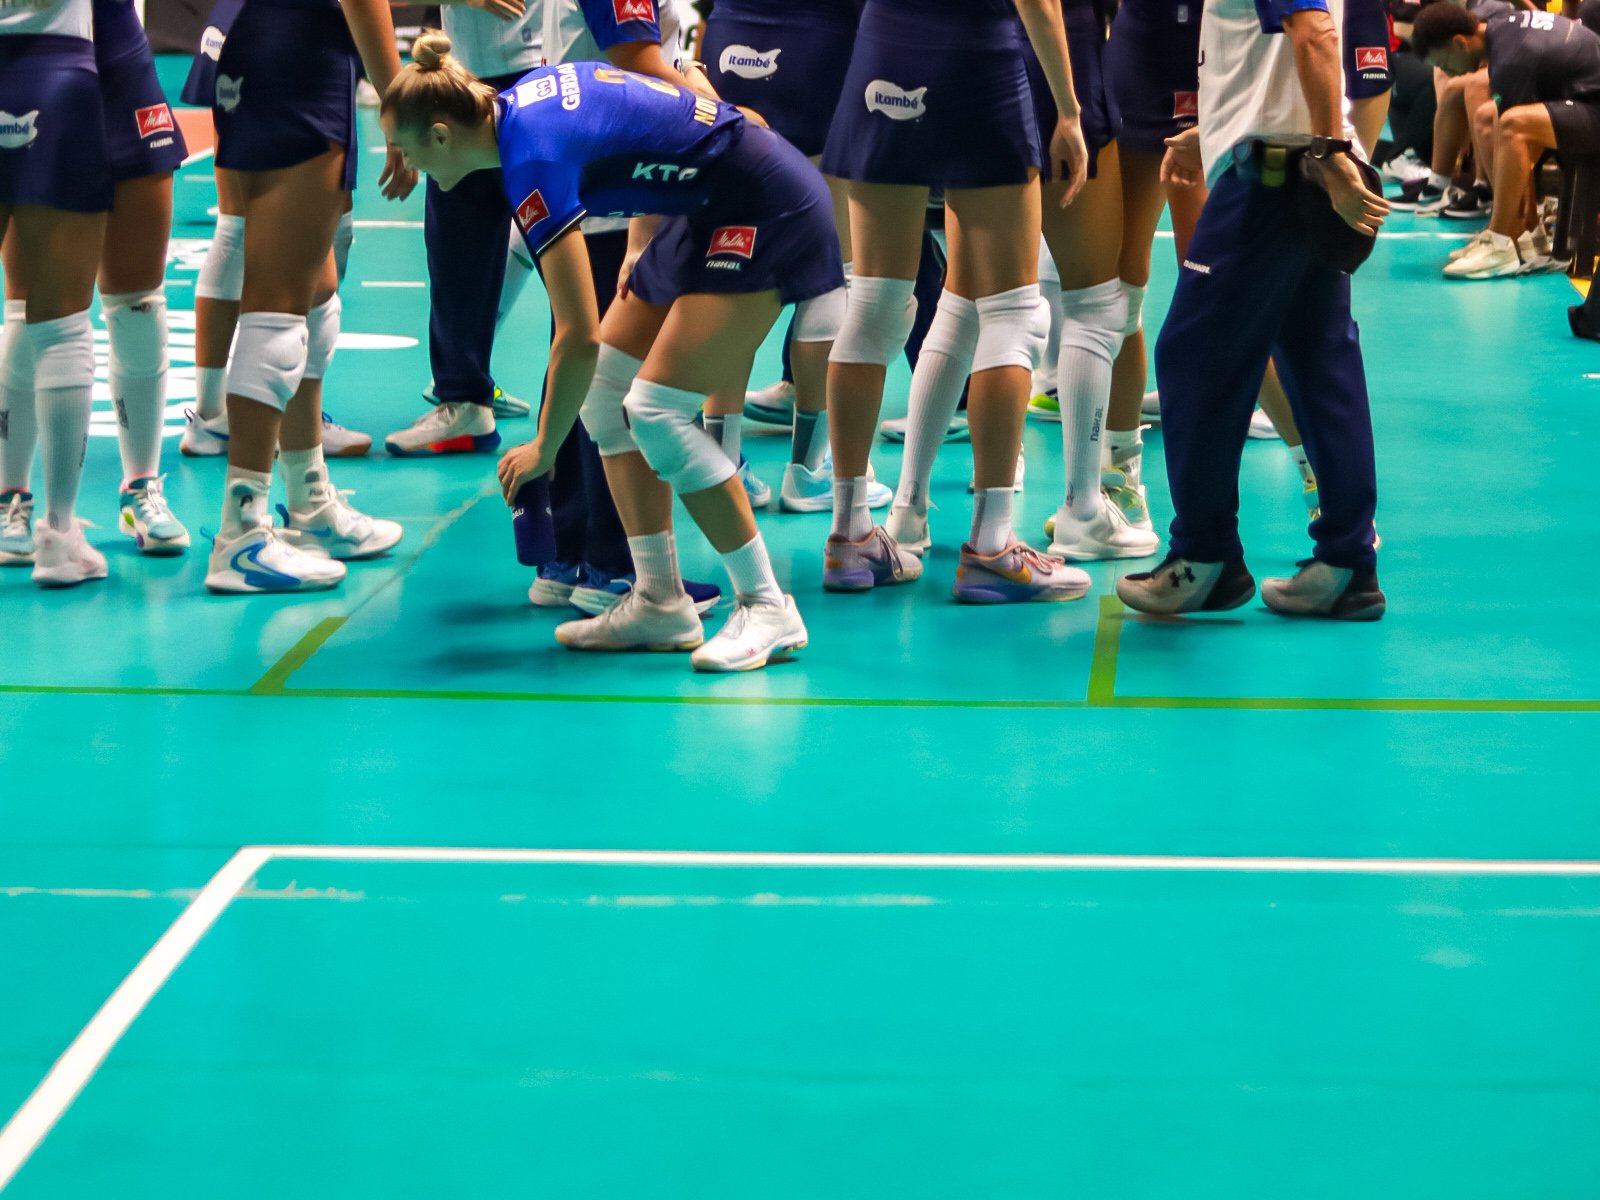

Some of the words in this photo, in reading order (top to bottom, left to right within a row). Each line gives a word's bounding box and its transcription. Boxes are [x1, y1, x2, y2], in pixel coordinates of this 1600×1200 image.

[728, 54, 770, 69] itambé
[875, 91, 918, 109] itambé
[632, 161, 699, 182] KTO
